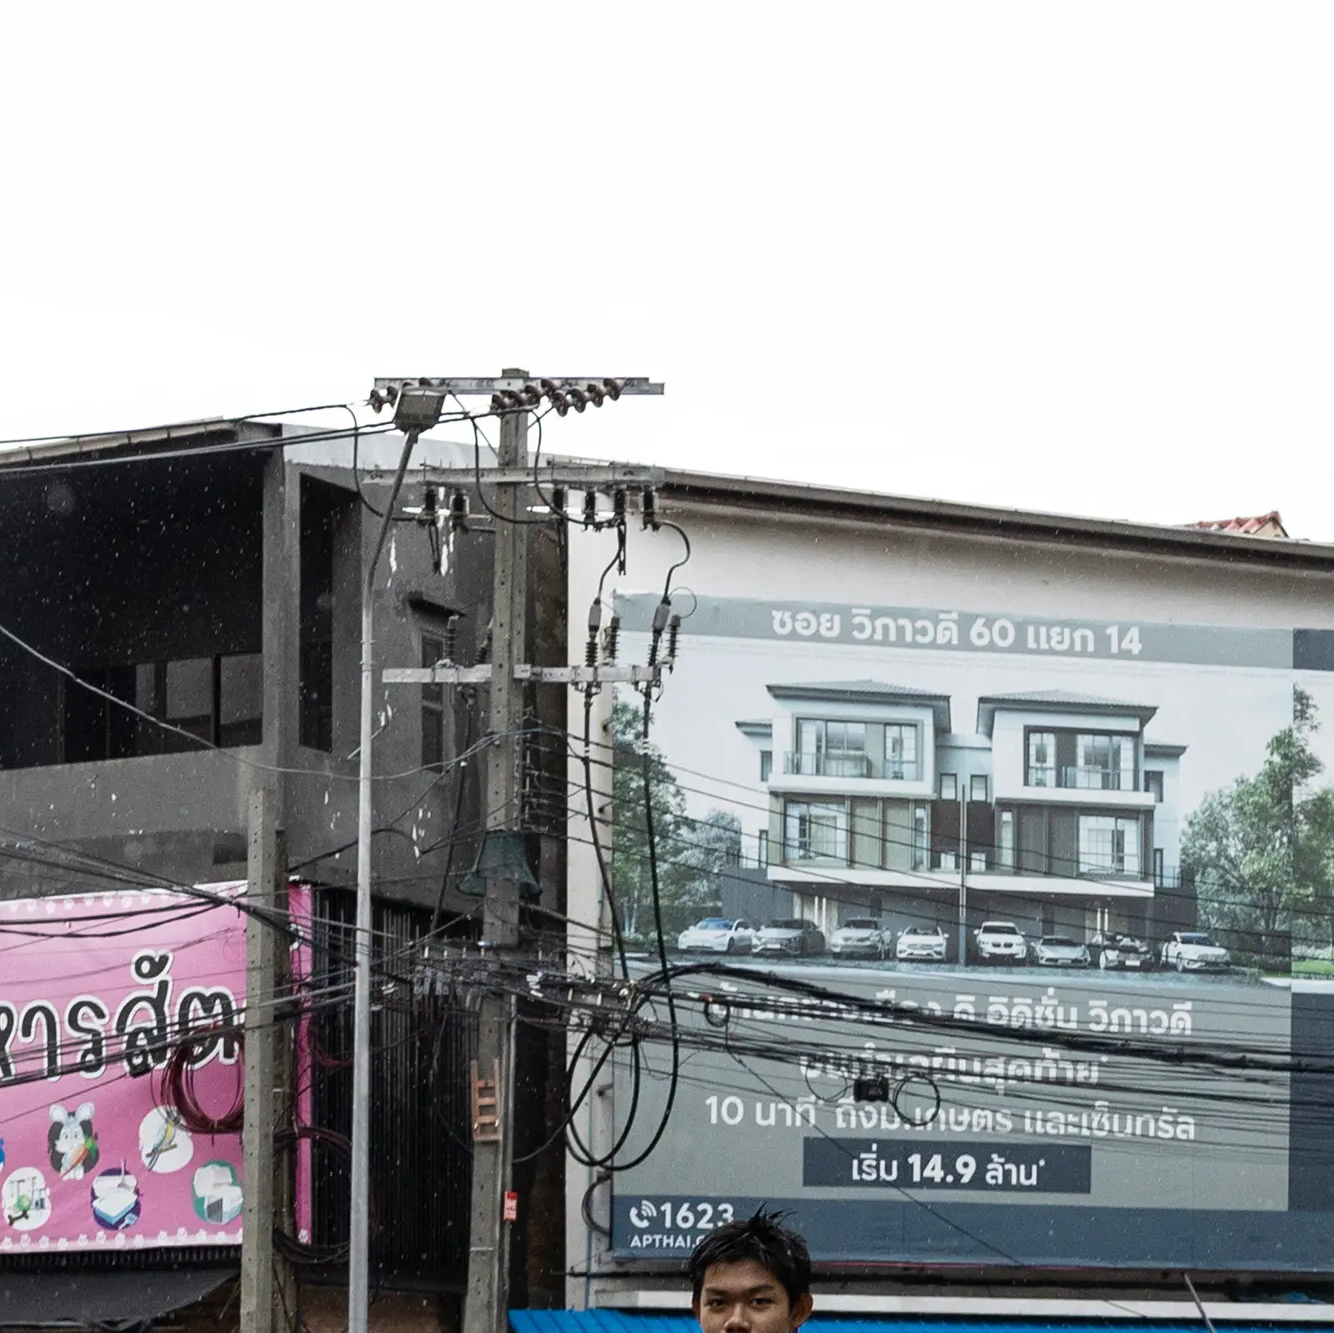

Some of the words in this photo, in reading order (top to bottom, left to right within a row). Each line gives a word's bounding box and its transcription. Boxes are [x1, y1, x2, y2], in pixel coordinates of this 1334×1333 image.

[772, 610, 841, 638] ซอย
[851, 607, 958, 645] วิภาวดี
[970, 618, 1014, 648] 60
[1027, 625, 1095, 652] แยก
[1105, 626, 1142, 655] 14
[1088, 999, 1192, 1036] วิภาวดี
[705, 1095, 744, 1126] 10
[851, 1143, 899, 1182] เริ่ม
[907, 1152, 977, 1185] 14.9
[660, 1202, 735, 1230] 1623
